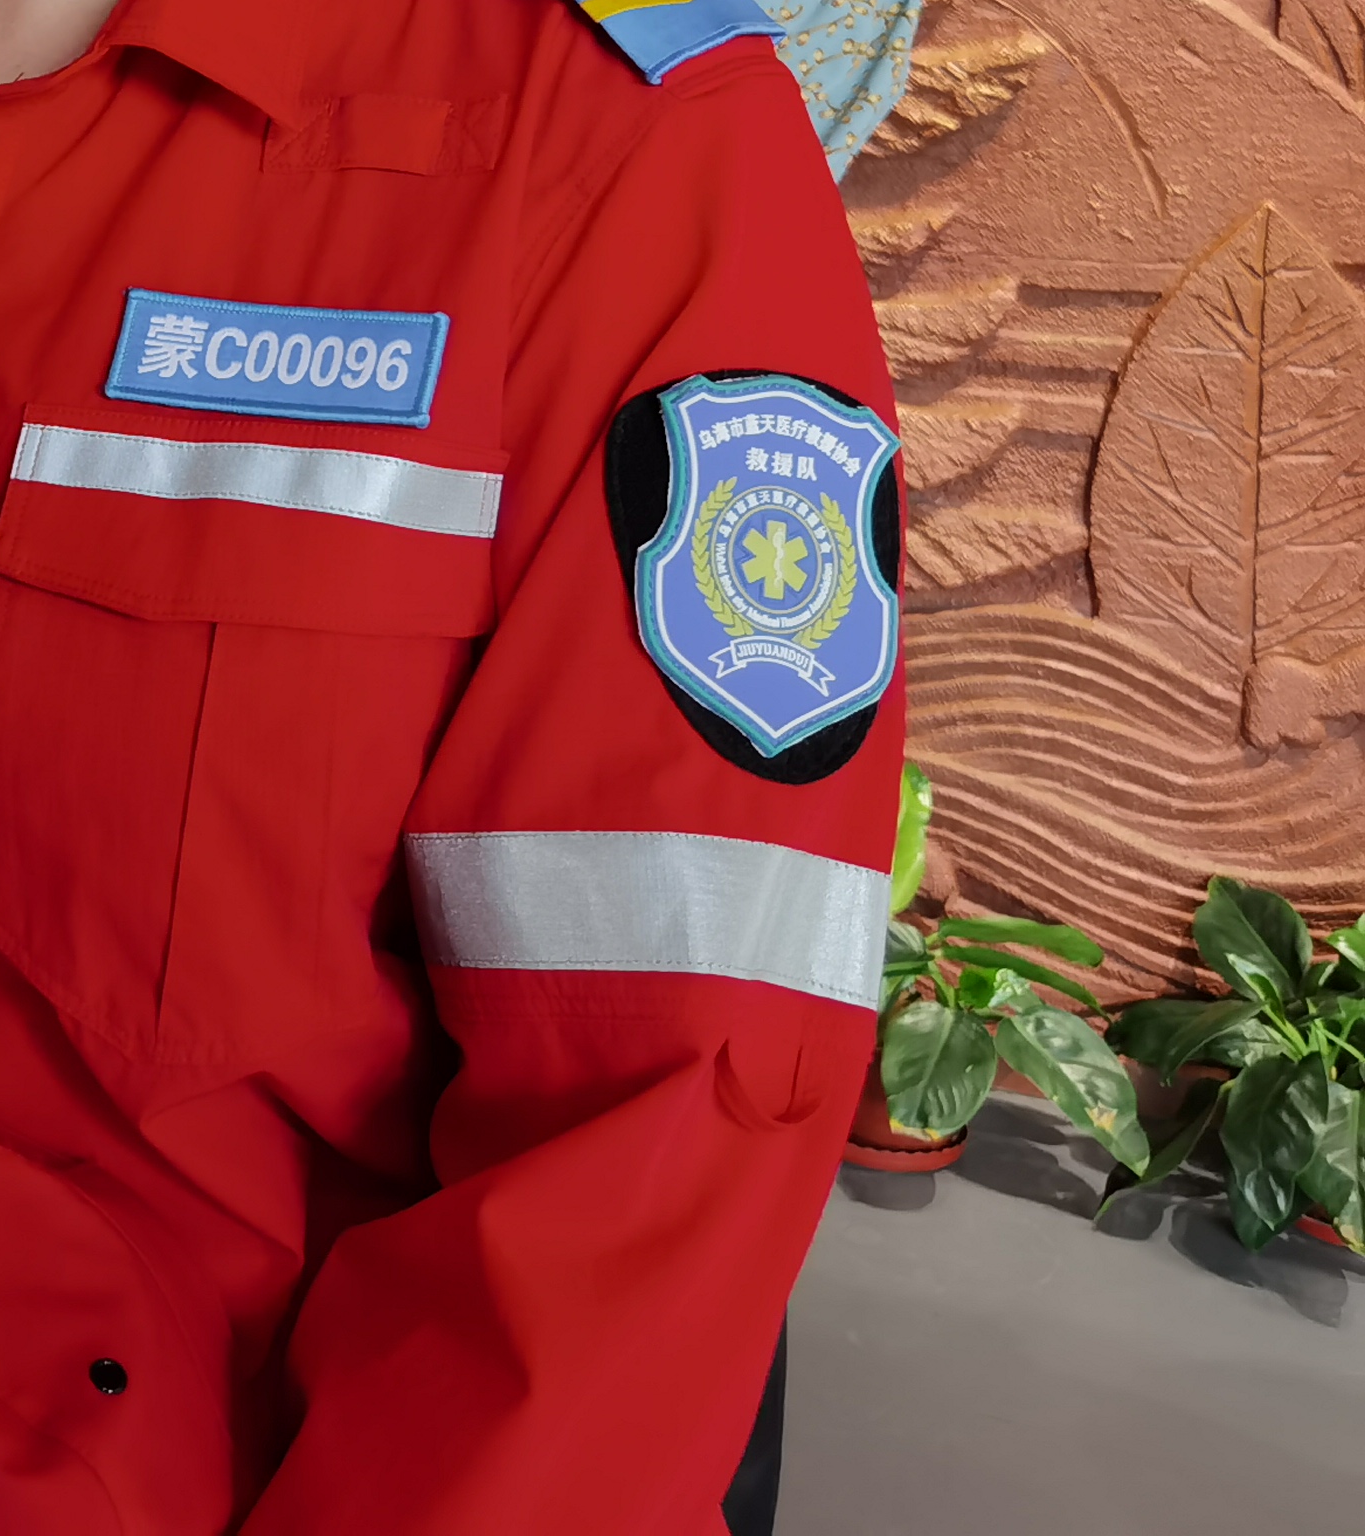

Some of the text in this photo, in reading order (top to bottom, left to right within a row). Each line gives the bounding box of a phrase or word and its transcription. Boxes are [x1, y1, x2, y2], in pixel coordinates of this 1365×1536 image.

[136, 312, 413, 392] 蒙C00096
[698, 413, 862, 478] 乌海市蓝天医疗救援协会
[744, 446, 818, 482] 救援队
[736, 642, 810, 669] JIUYUANDUI
